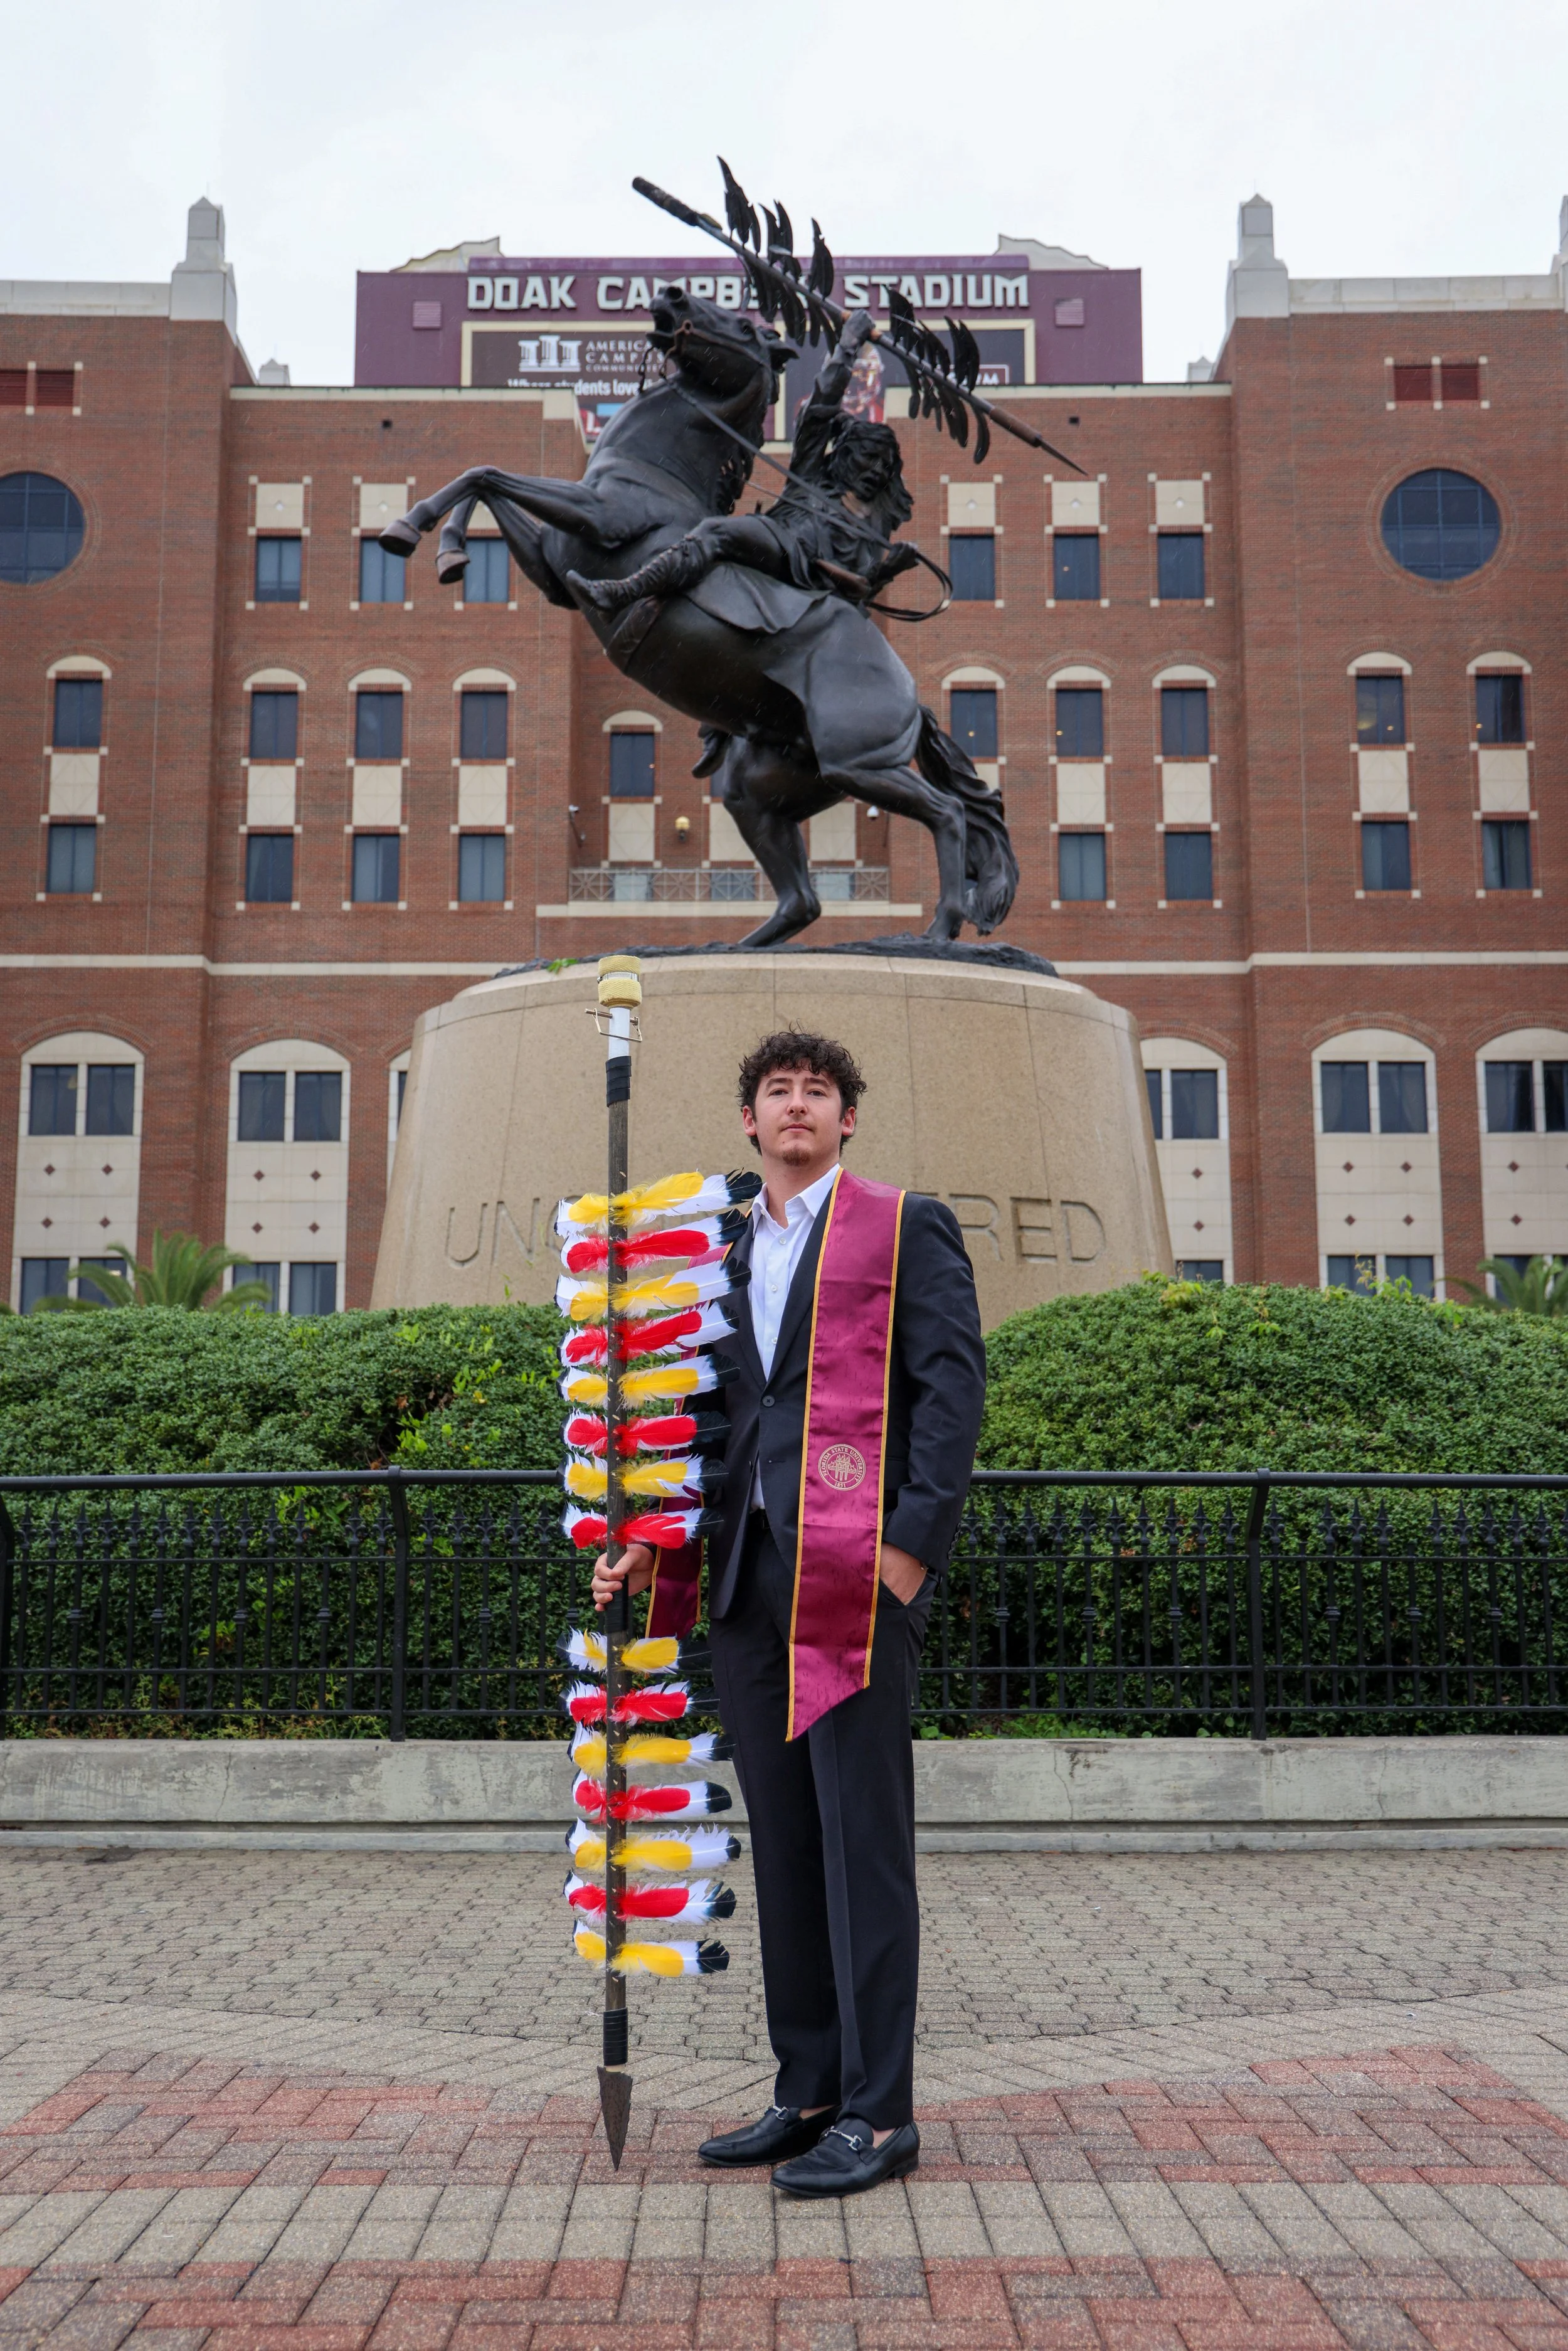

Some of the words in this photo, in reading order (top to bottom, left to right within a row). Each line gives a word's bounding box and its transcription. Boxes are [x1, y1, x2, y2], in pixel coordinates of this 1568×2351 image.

[467, 275, 577, 310] DOAK
[843, 274, 1030, 308] STADIUM
[822, 1453, 831, 1476] FLORIDA
[850, 1450, 863, 1482] UNIVERSITY
